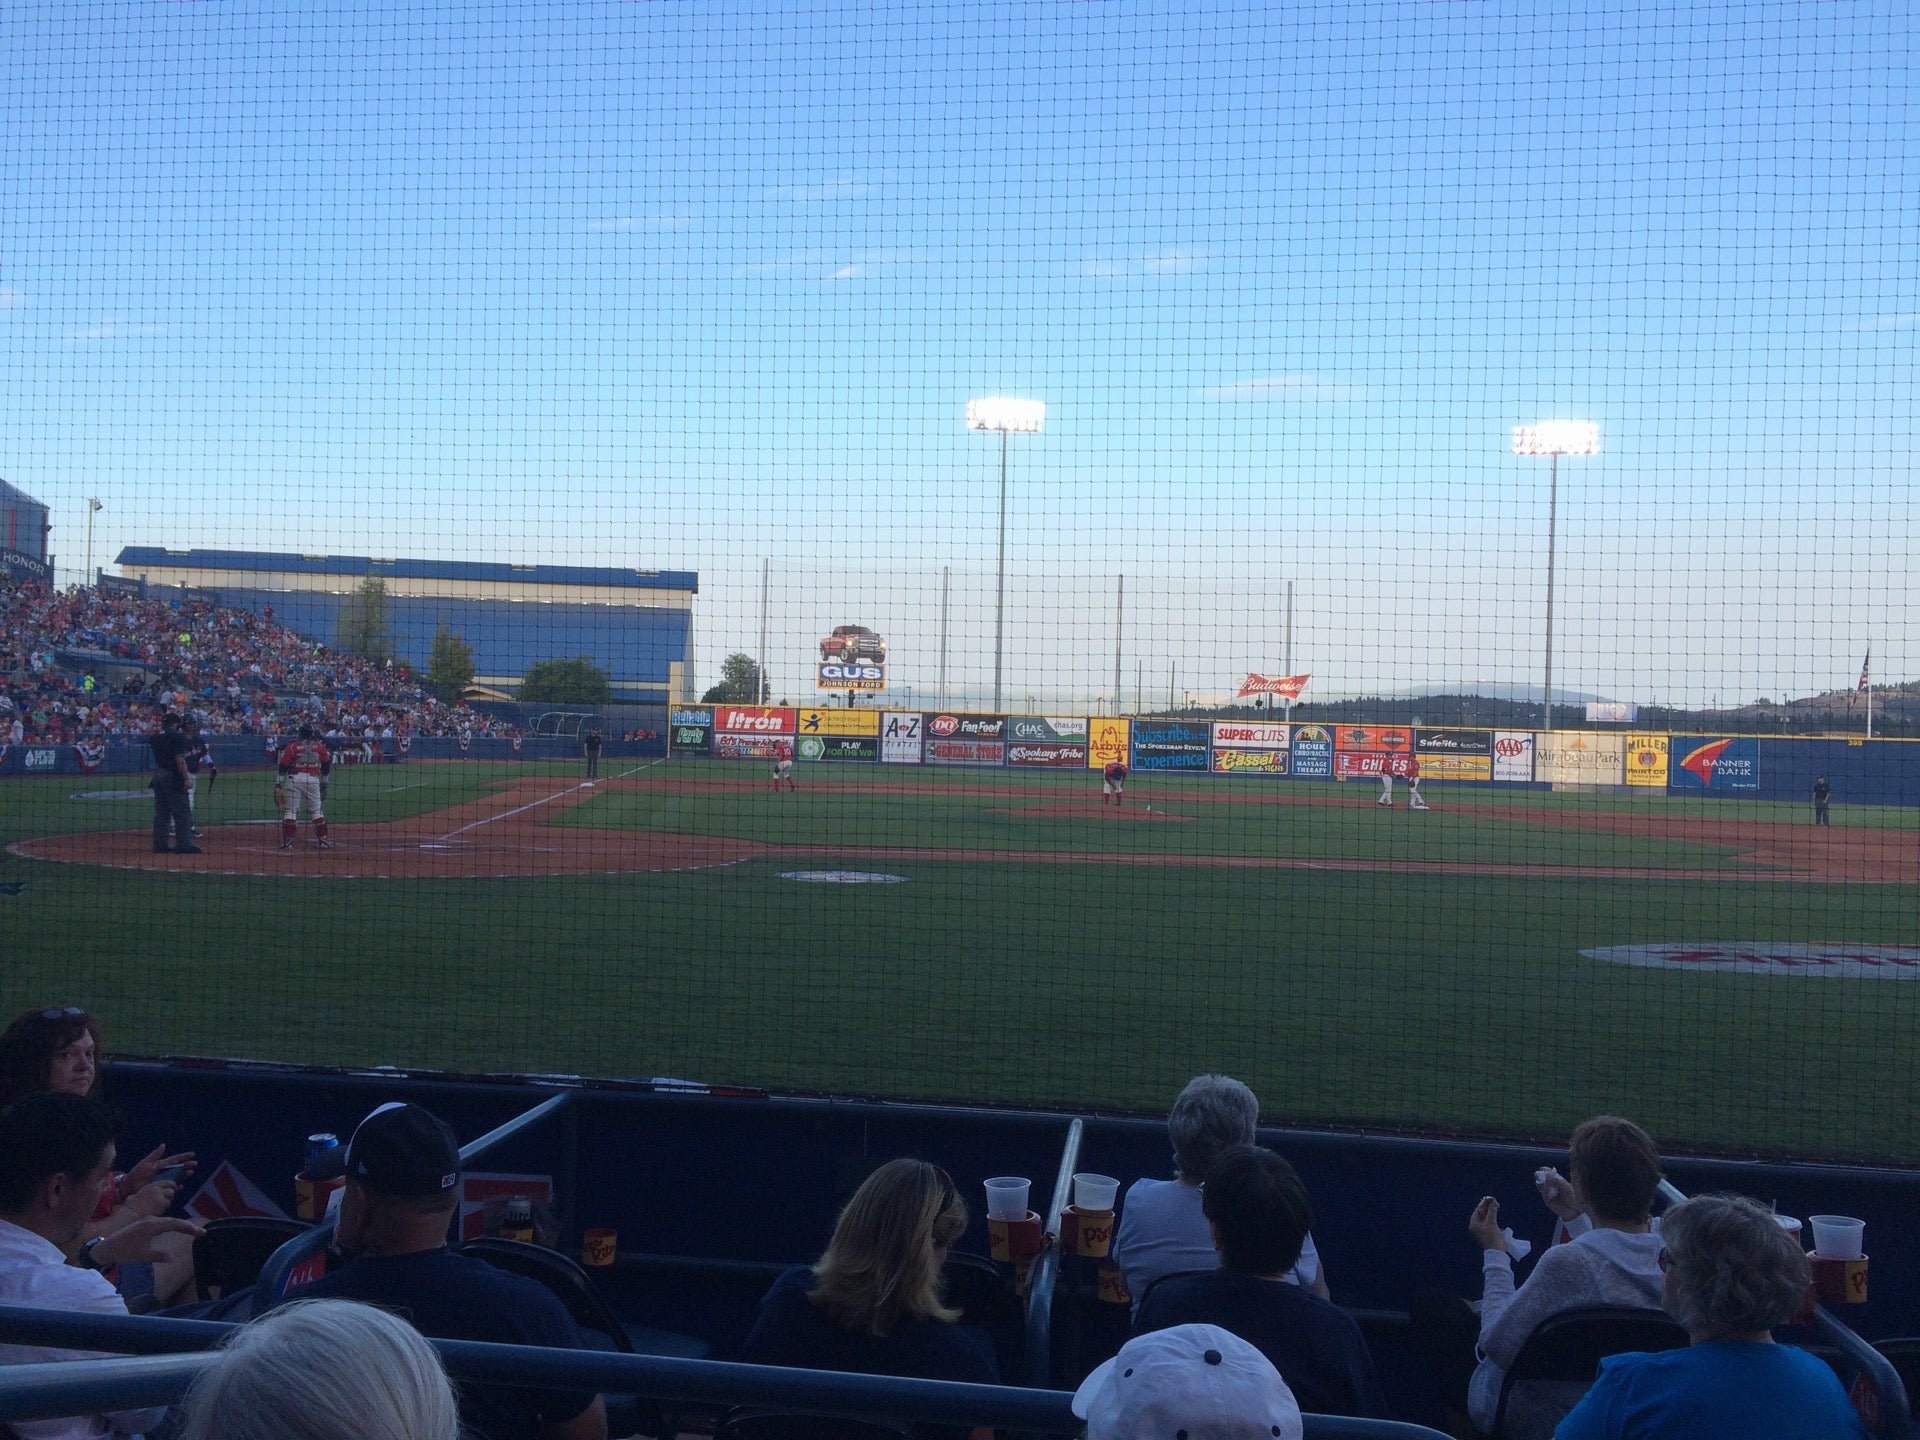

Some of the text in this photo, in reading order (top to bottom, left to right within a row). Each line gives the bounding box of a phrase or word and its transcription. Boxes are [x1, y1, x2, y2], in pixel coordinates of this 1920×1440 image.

[3, 551, 45, 576] HONOR
[822, 666, 881, 679] GUS
[726, 711, 783, 730] Itron
[1054, 722, 1083, 730] chas.org
[1015, 722, 1044, 737] CHAS
[1133, 721, 1190, 743] Subscribe
[1217, 728, 1285, 742] SUPERCUTS
[827, 748, 843, 756] FOR
[845, 749, 859, 757] THE
[860, 749, 876, 757] WIN
[841, 741, 861, 750] PLAY
[936, 744, 974, 758] GENERAL
[1090, 740, 1128, 754] Arby's
[1496, 739, 1522, 757] AAA
[1628, 738, 1667, 754] MILLER
[1018, 747, 1084, 759] Spokane Tribe
[1133, 749, 1209, 769] Experience!
[1361, 758, 1408, 772] CHIFS
[1702, 759, 1751, 768] BANNER
[1717, 767, 1751, 776] BANK
